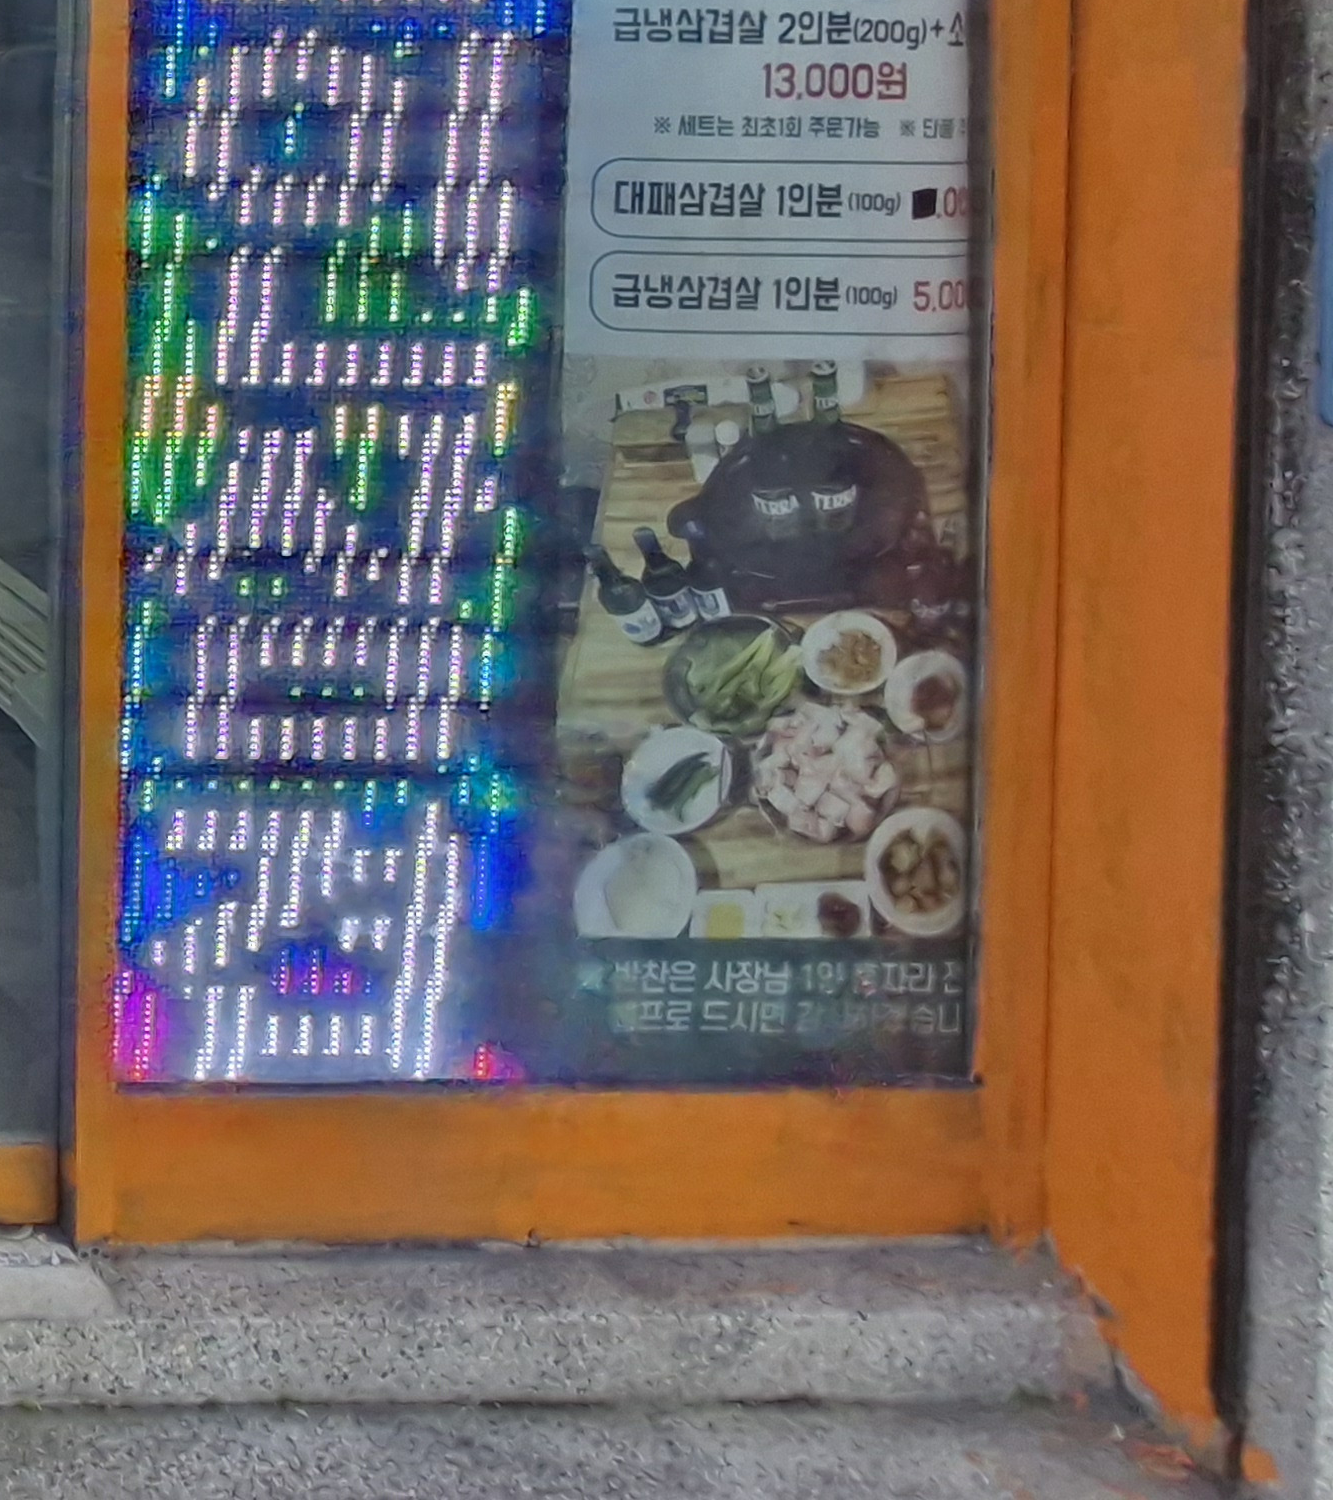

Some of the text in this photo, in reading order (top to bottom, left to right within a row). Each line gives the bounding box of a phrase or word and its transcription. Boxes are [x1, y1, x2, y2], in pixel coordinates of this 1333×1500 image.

[612, 7, 767, 46] 급냉삼겹살
[678, 114, 735, 137] 세트는
[808, 115, 880, 139] 주문가능
[614, 181, 766, 219] 대패삼겹살
[777, 183, 843, 219] 1인분
[611, 273, 763, 312] 급냉삼겹살
[774, 275, 840, 312] 1인분
[704, 959, 791, 996] 사장님
